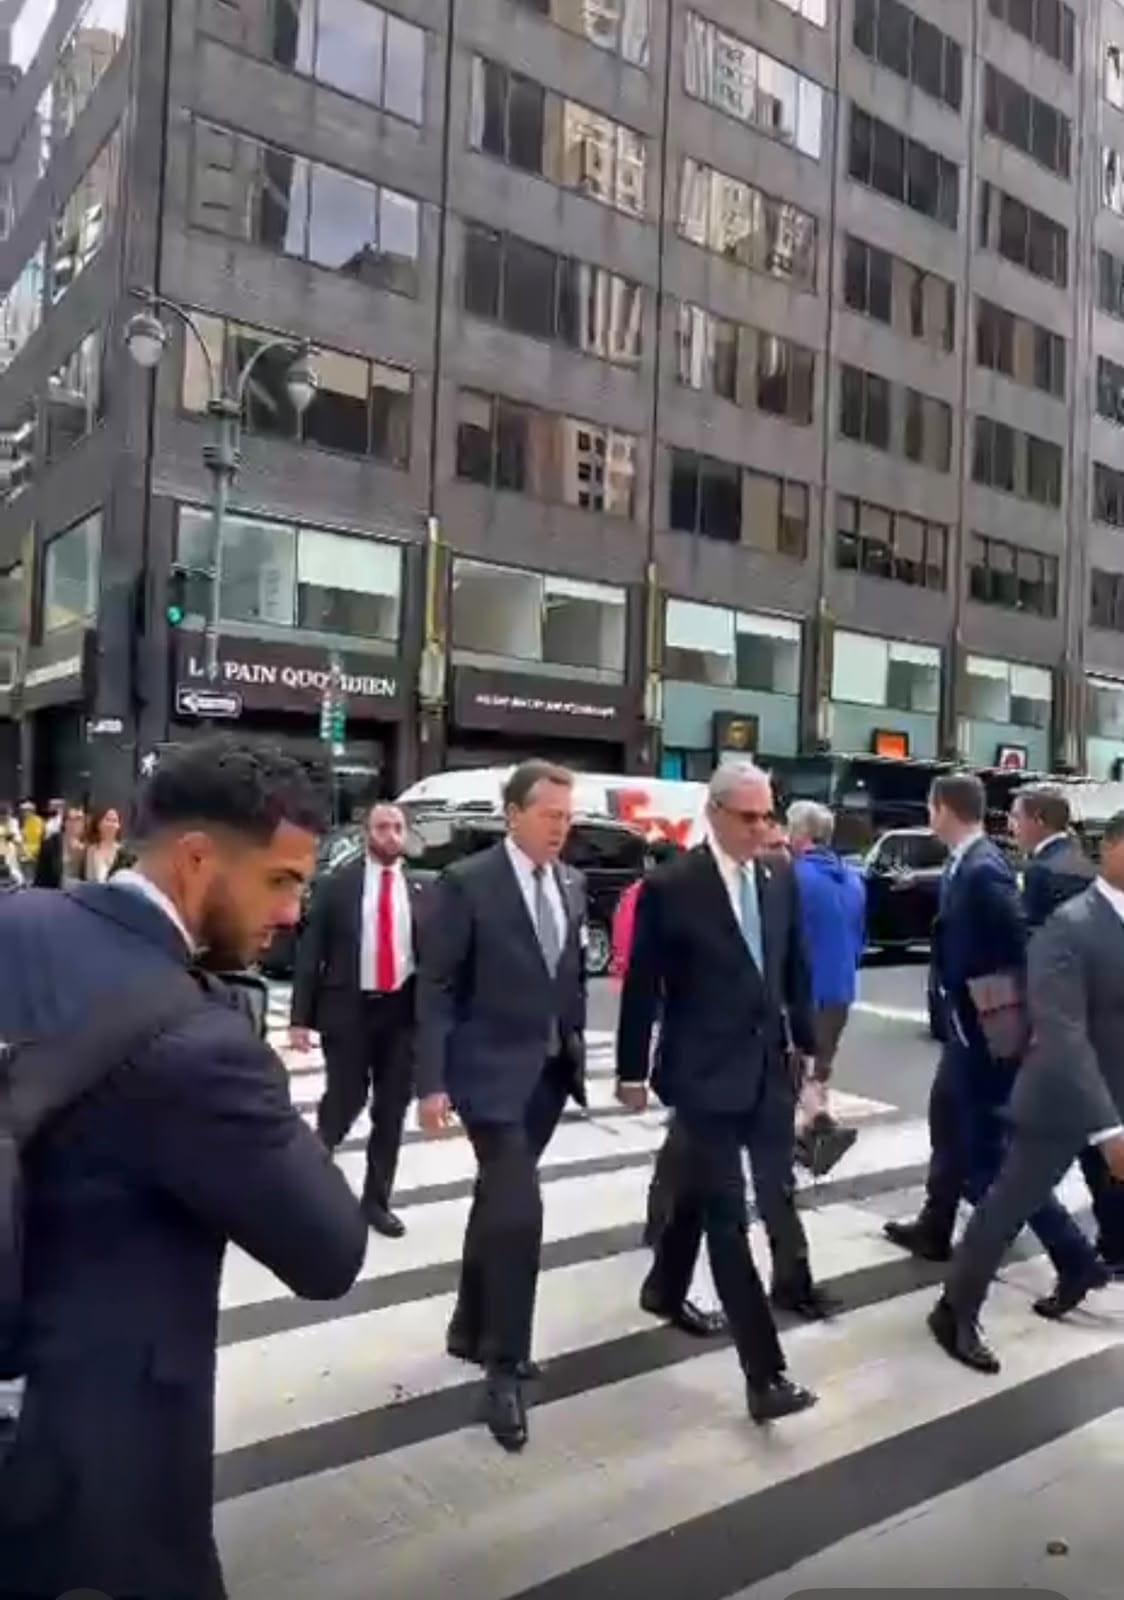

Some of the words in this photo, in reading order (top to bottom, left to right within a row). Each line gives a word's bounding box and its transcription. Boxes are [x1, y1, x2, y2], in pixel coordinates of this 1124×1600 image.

[188, 657, 217, 680] L
[223, 661, 278, 684] PAIN
[281, 667, 396, 697] QUOIDIEN
